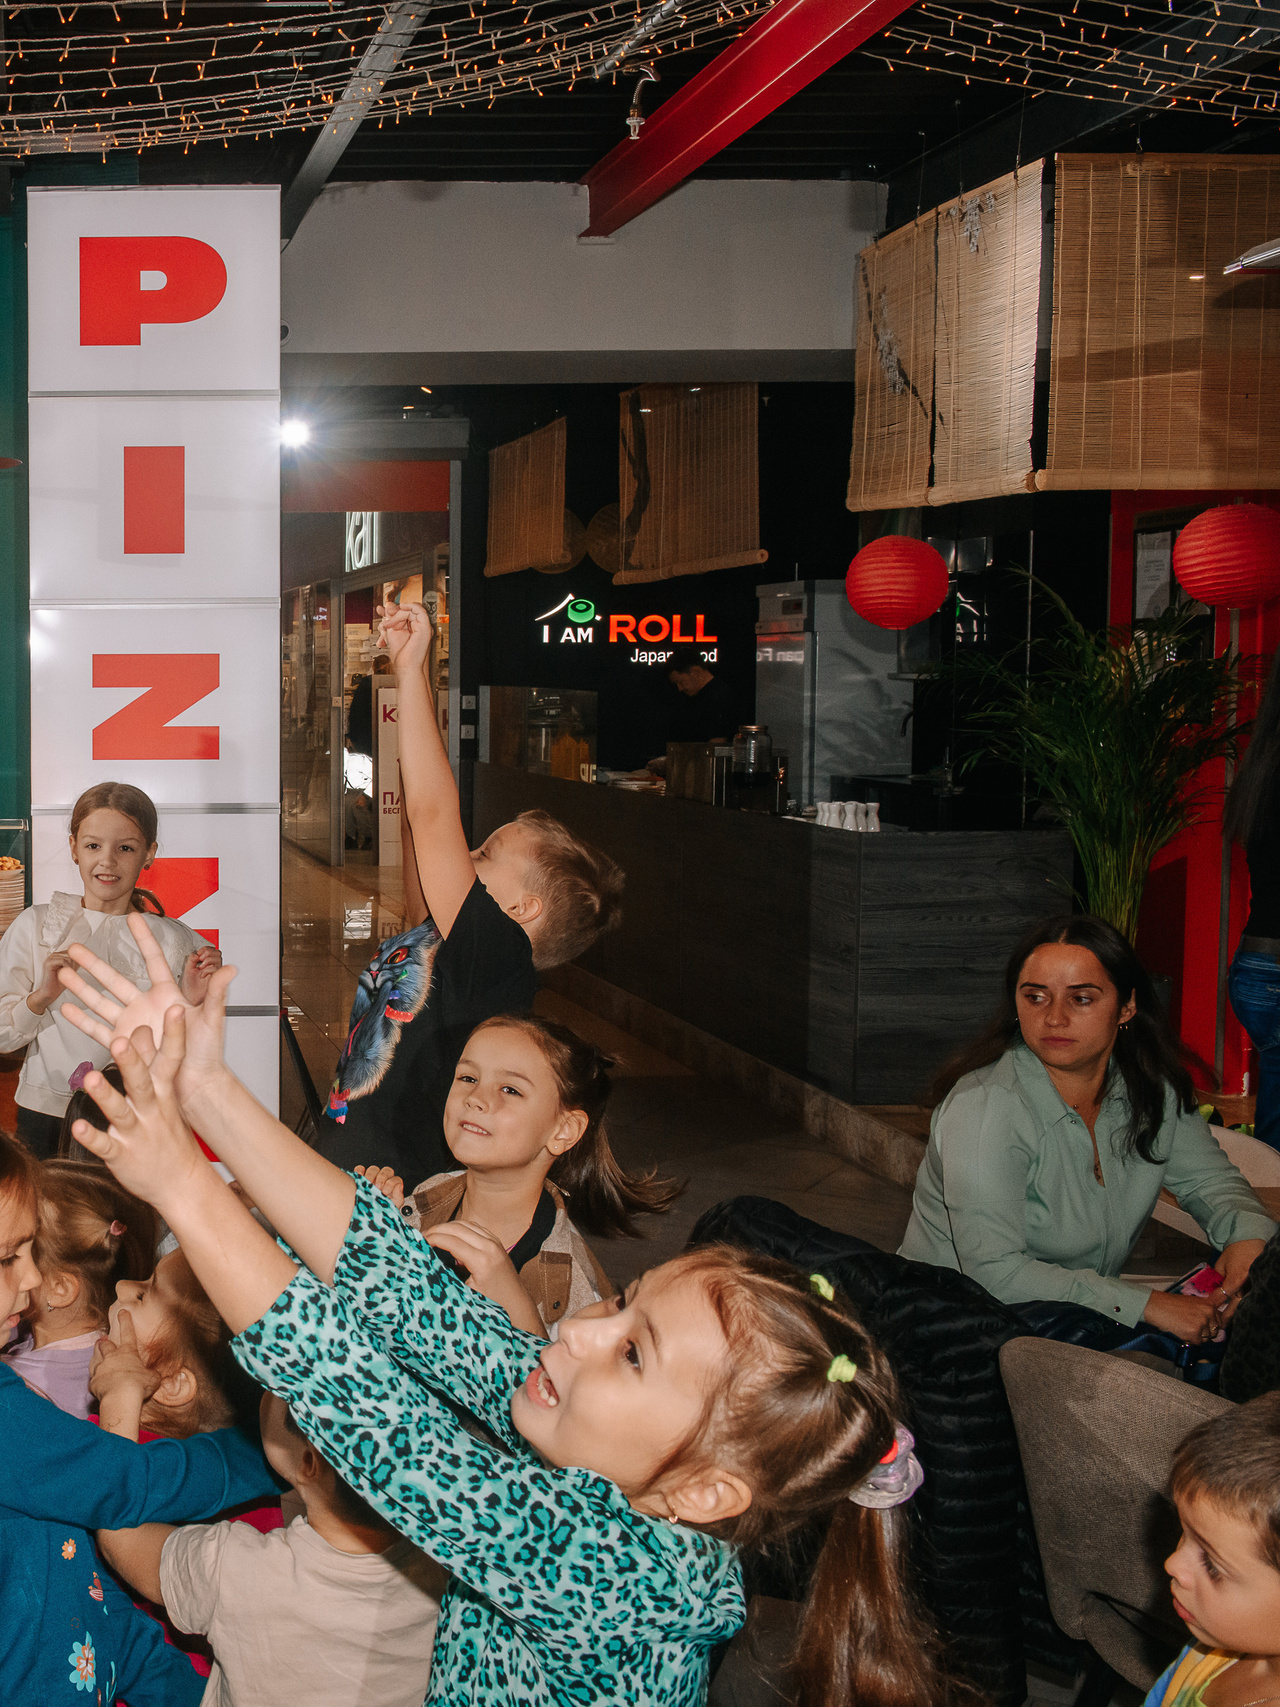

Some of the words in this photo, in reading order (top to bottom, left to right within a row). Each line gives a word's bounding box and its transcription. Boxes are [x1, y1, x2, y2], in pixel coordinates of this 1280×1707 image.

[79, 236, 228, 1162] PIZ
[543, 625, 550, 643] I
[560, 627, 593, 643] AM
[608, 614, 718, 643] ROLL
